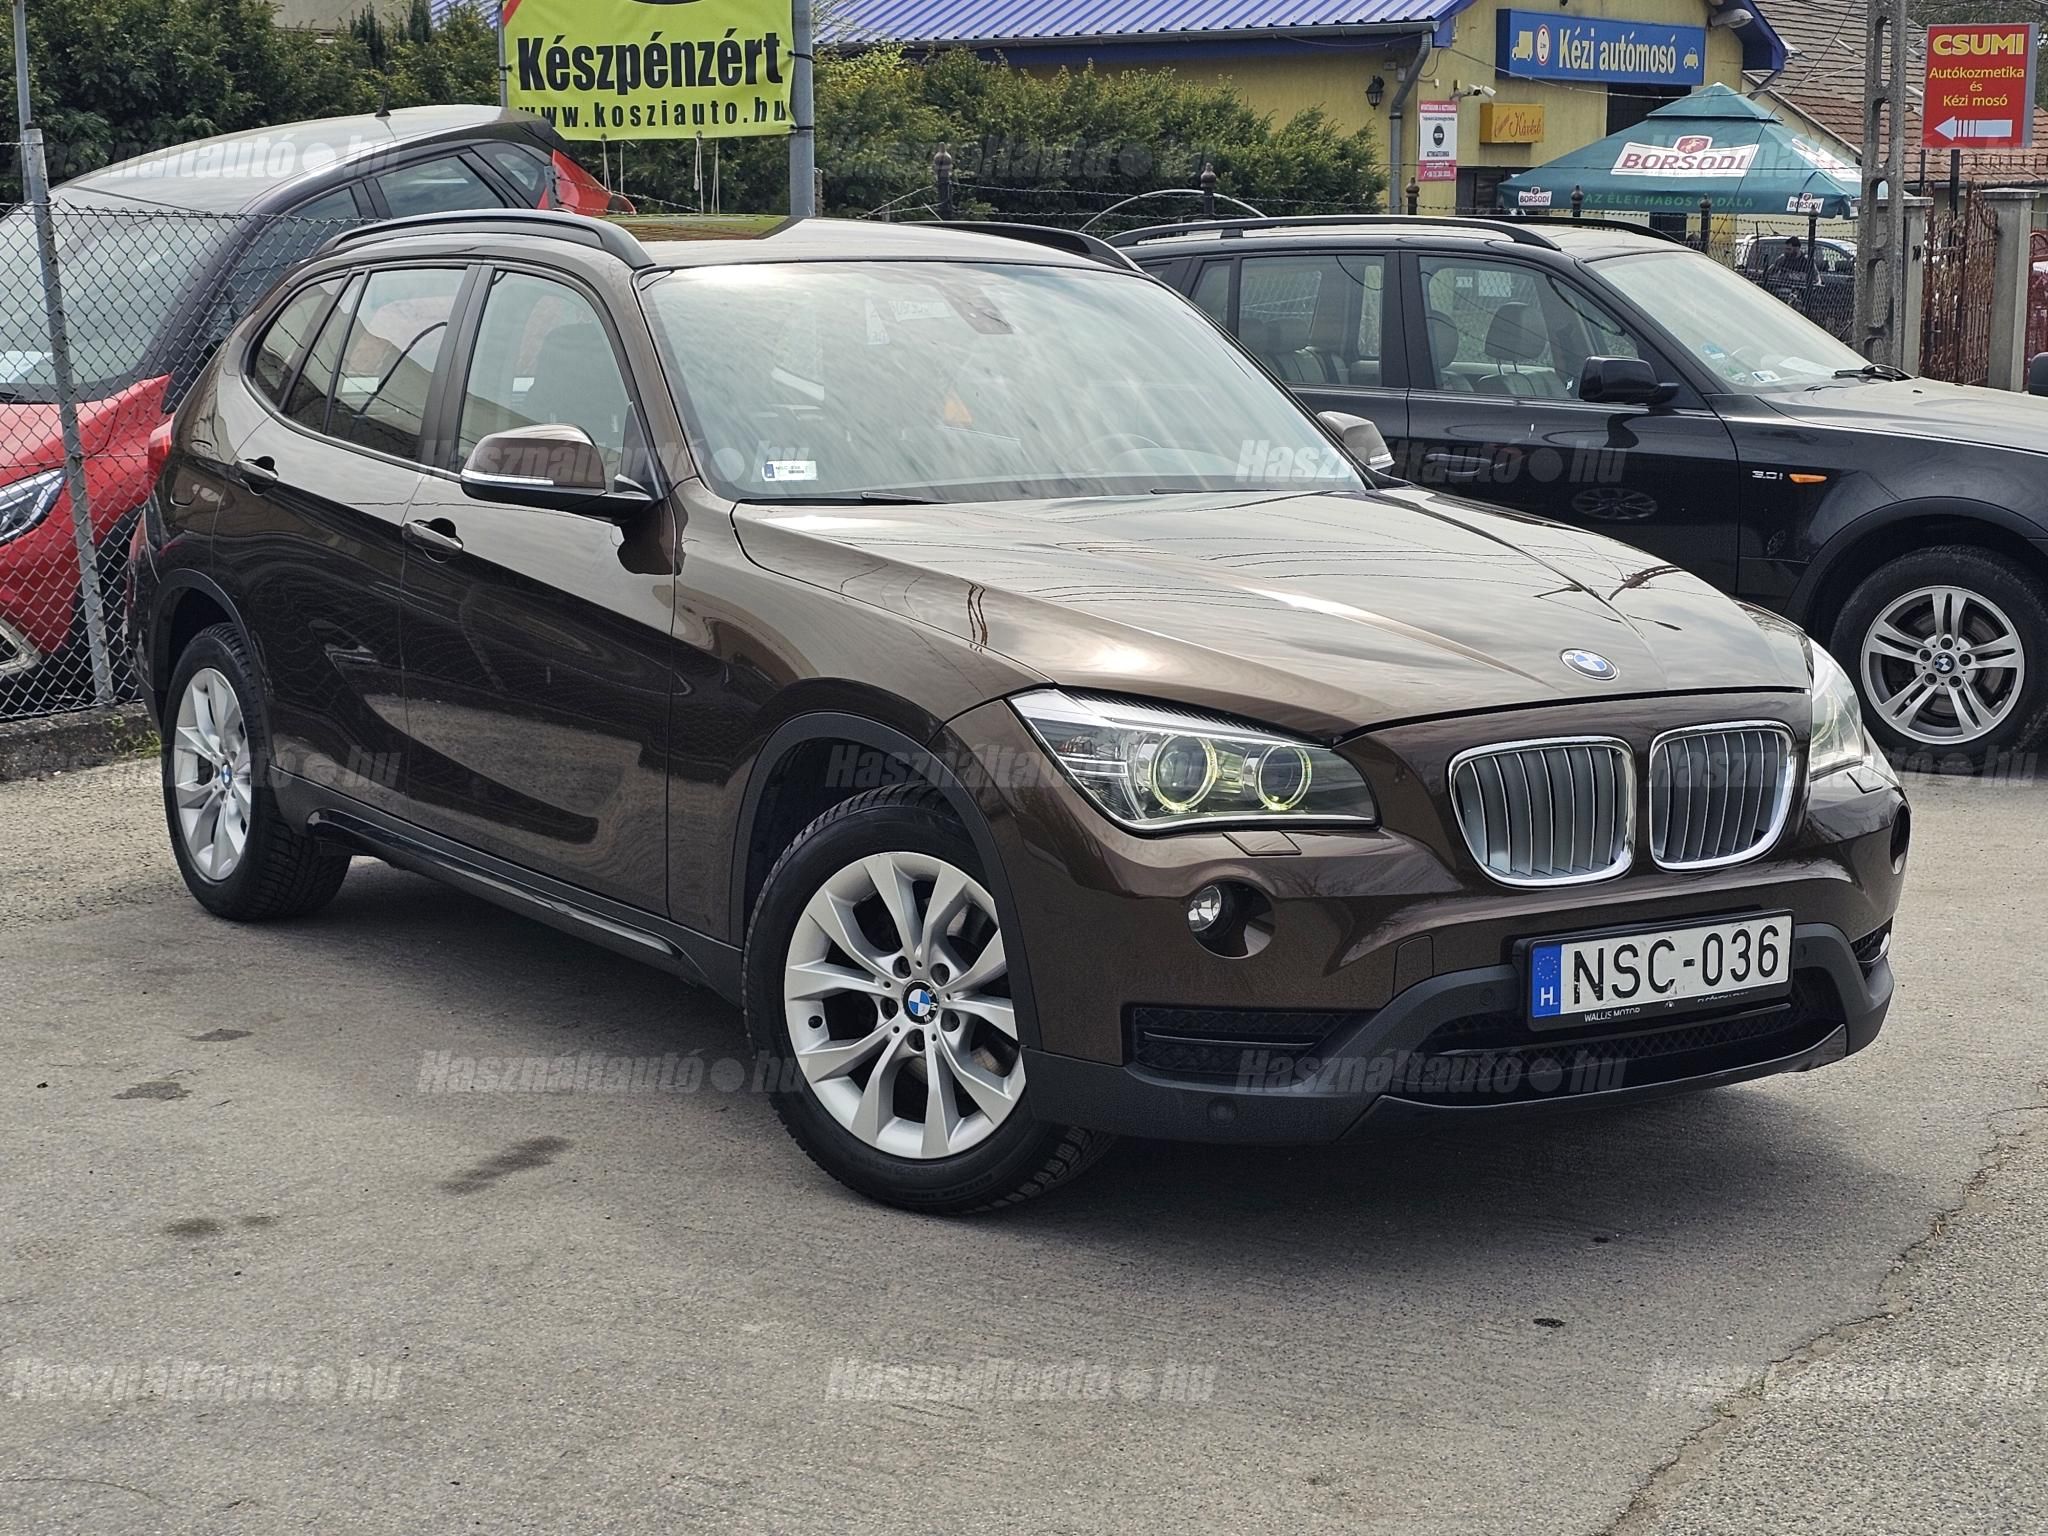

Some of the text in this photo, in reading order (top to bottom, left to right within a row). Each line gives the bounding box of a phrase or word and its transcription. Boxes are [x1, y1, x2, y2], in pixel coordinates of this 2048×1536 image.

[1558, 26, 1677, 74] Kézi autómosó
[1932, 33, 2025, 56] CSUMI
[517, 28, 783, 96] Készpénzért
[1929, 66, 2025, 79] Autókozmetika
[1969, 81, 1983, 92] és
[1943, 94, 2008, 107] Kézi mosó
[1621, 154, 1747, 171] BORSODI
[1584, 194, 1603, 204] AZ
[1607, 192, 1641, 206] ÉLET
[1573, 924, 1779, 1004] NSC-036
[1540, 986, 1554, 1006] H
[1584, 1010, 1613, 1023] WALLIS
